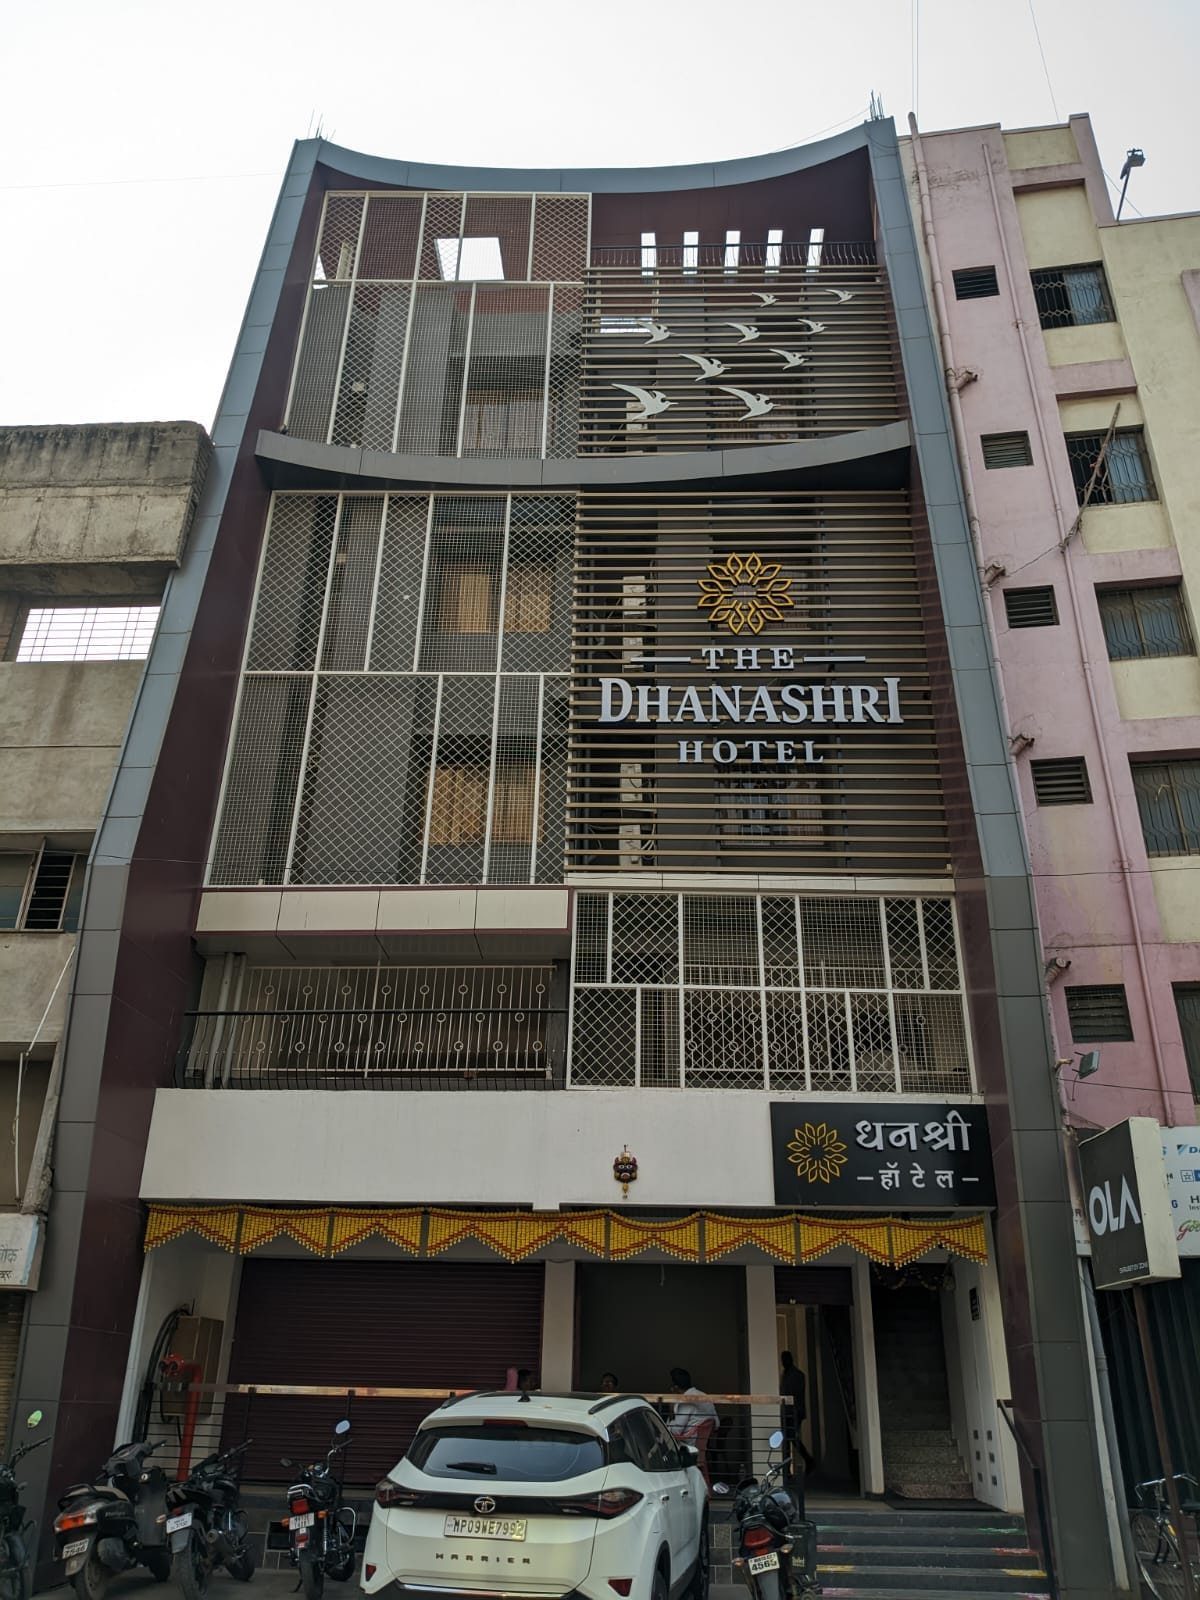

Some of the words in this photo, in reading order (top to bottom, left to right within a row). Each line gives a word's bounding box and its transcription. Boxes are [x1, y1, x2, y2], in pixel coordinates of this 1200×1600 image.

[701, 647, 795, 670] THE
[598, 677, 905, 724] DHANASHRI
[677, 740, 824, 764] HOTEL
[855, 1109, 973, 1151] धनश्री
[878, 1161, 954, 1190] हॉटेल
[1088, 1173, 1142, 1236] OLA
[435, 1552, 531, 1565] HARRIER
